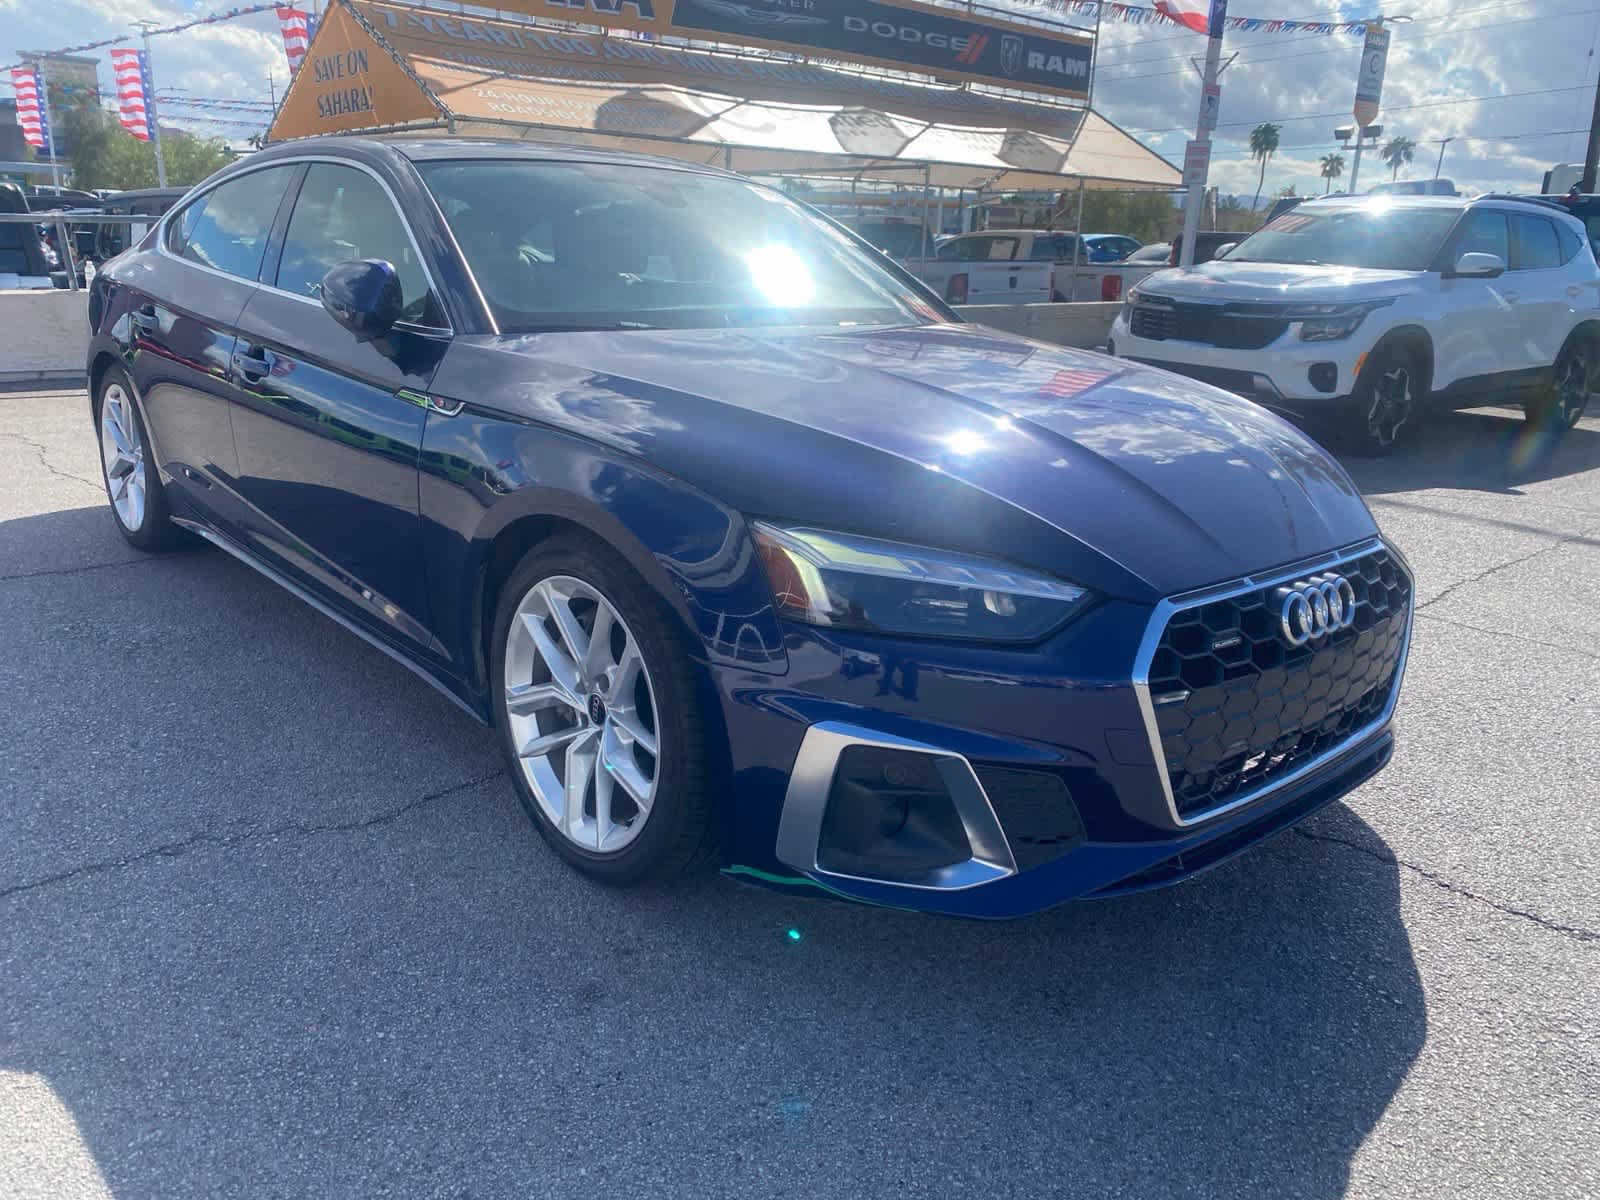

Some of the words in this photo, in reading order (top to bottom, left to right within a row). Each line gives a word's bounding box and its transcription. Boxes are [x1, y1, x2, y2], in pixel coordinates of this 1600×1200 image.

[843, 16, 970, 51] DODGE
[314, 53, 345, 83] SAVE
[347, 48, 369, 76] ON
[1027, 52, 1087, 77] RAM
[316, 84, 376, 118] SAHARA!
